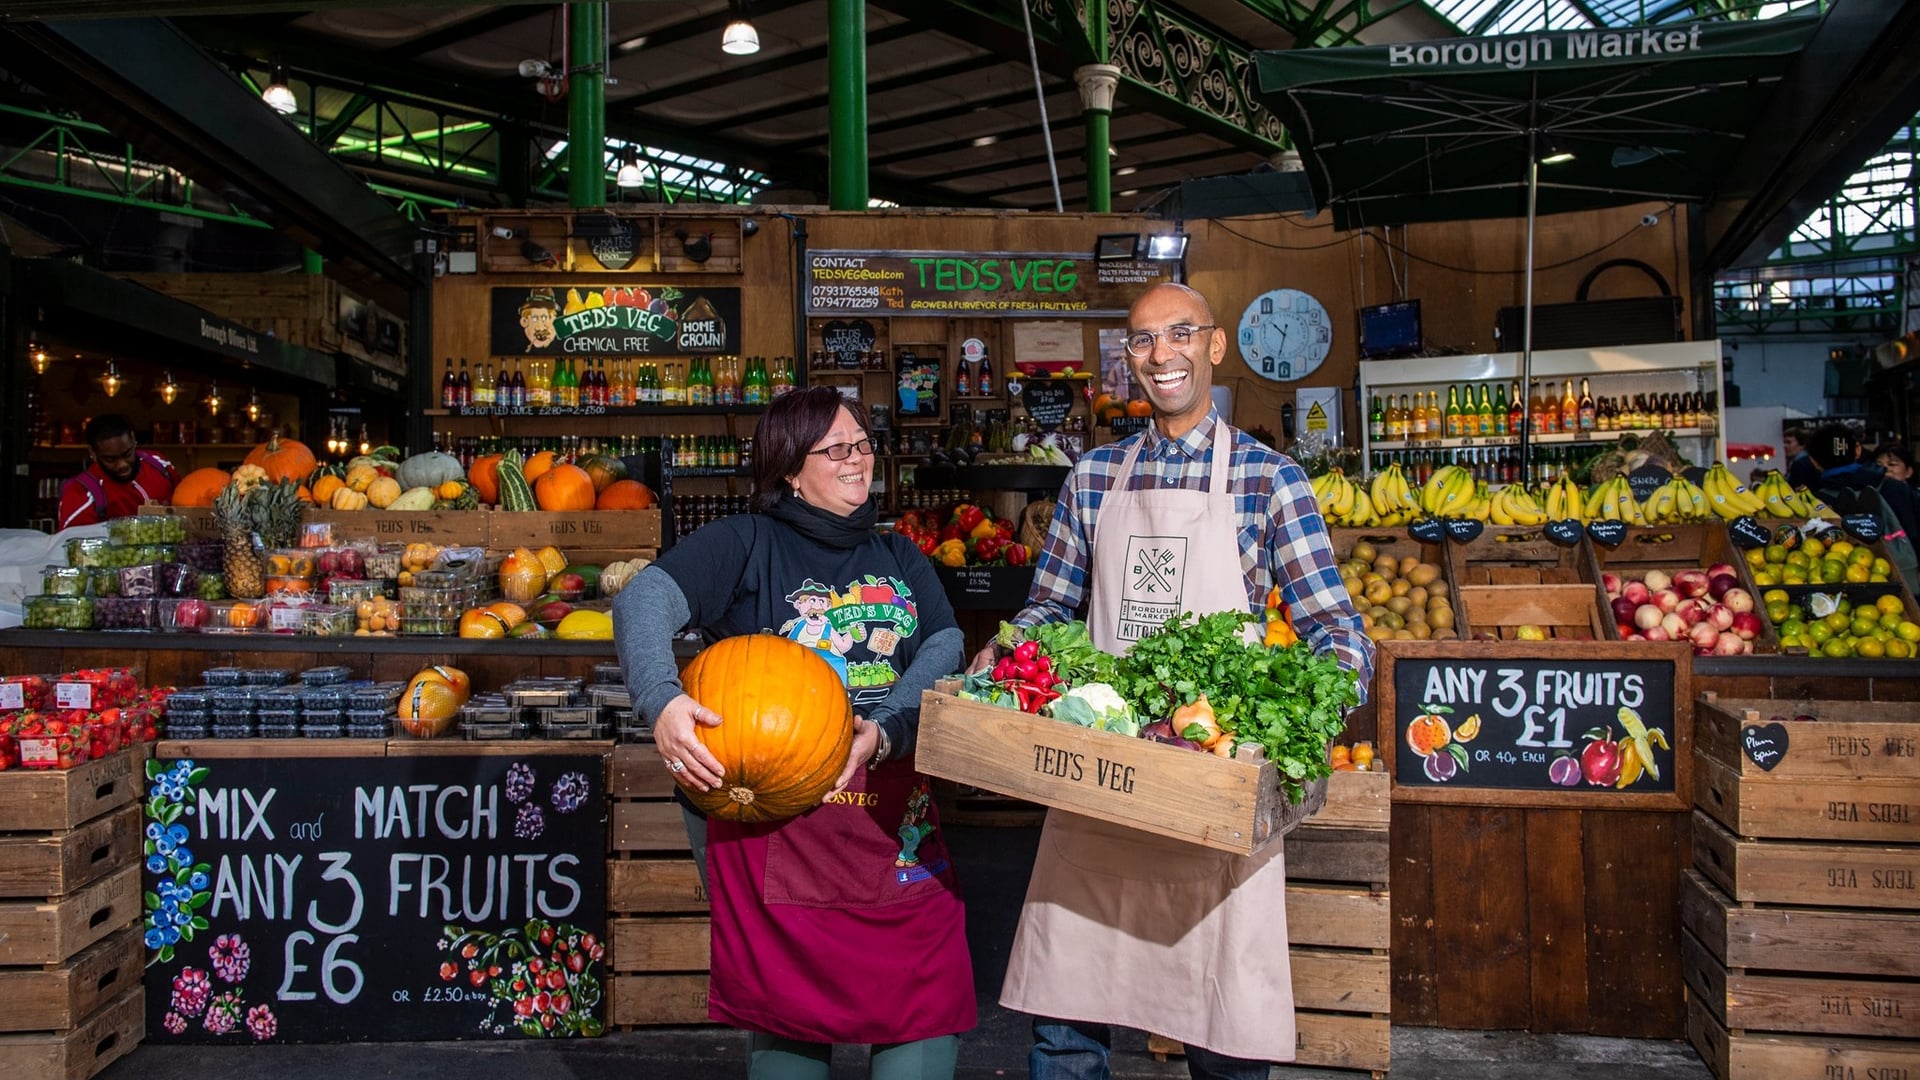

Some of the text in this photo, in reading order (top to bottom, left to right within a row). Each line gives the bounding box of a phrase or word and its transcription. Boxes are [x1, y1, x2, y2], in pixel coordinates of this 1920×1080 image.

[1389, 23, 1703, 69] Borough Market
[813, 257, 866, 268] CONTACT
[1009, 260, 1078, 293] VEG
[812, 286, 903, 297] 07931765348 Kath
[812, 297, 904, 308] 07947712259 Ted
[999, 300, 1009, 309] OF
[1011, 300, 1039, 310] FRESH
[563, 306, 661, 334] TED'S VEG
[683, 321, 715, 332] HOME
[563, 337, 650, 352] CHEMICAL FREE
[839, 351, 857, 360] VEG
[1263, 358, 1273, 371] 7
[511, 406, 534, 416] JUICE
[375, 520, 404, 534] TED'S
[549, 520, 603, 535] TED'S VEG
[1151, 548, 1159, 557] T
[1133, 565, 1176, 576] B M
[1147, 583, 1156, 593] K
[833, 604, 913, 628] TED'S VEG
[1134, 611, 1171, 620] MARKET
[1123, 623, 1163, 639] KITCH
[1423, 666, 1645, 717] ANY 3 FRUITS
[1515, 704, 1573, 748] £1
[1745, 736, 1774, 749] Plum
[1827, 736, 1916, 757] TED'S VEG
[1475, 750, 1546, 764] OR 40p EACH
[1753, 750, 1779, 763] Spain
[1034, 744, 1136, 795] TED'S VEG
[199, 784, 498, 841] MIX and MATCH
[1828, 802, 1912, 824] TED'S VEG
[1827, 868, 1916, 890] TED'S VEG
[210, 851, 581, 935] ANY 3 FRUITS
[277, 930, 365, 1005] £6
[392, 990, 410, 1002] OR
[423, 986, 463, 1002] £2.50
[472, 991, 487, 1001] box
[1820, 995, 1852, 1016] VEG
